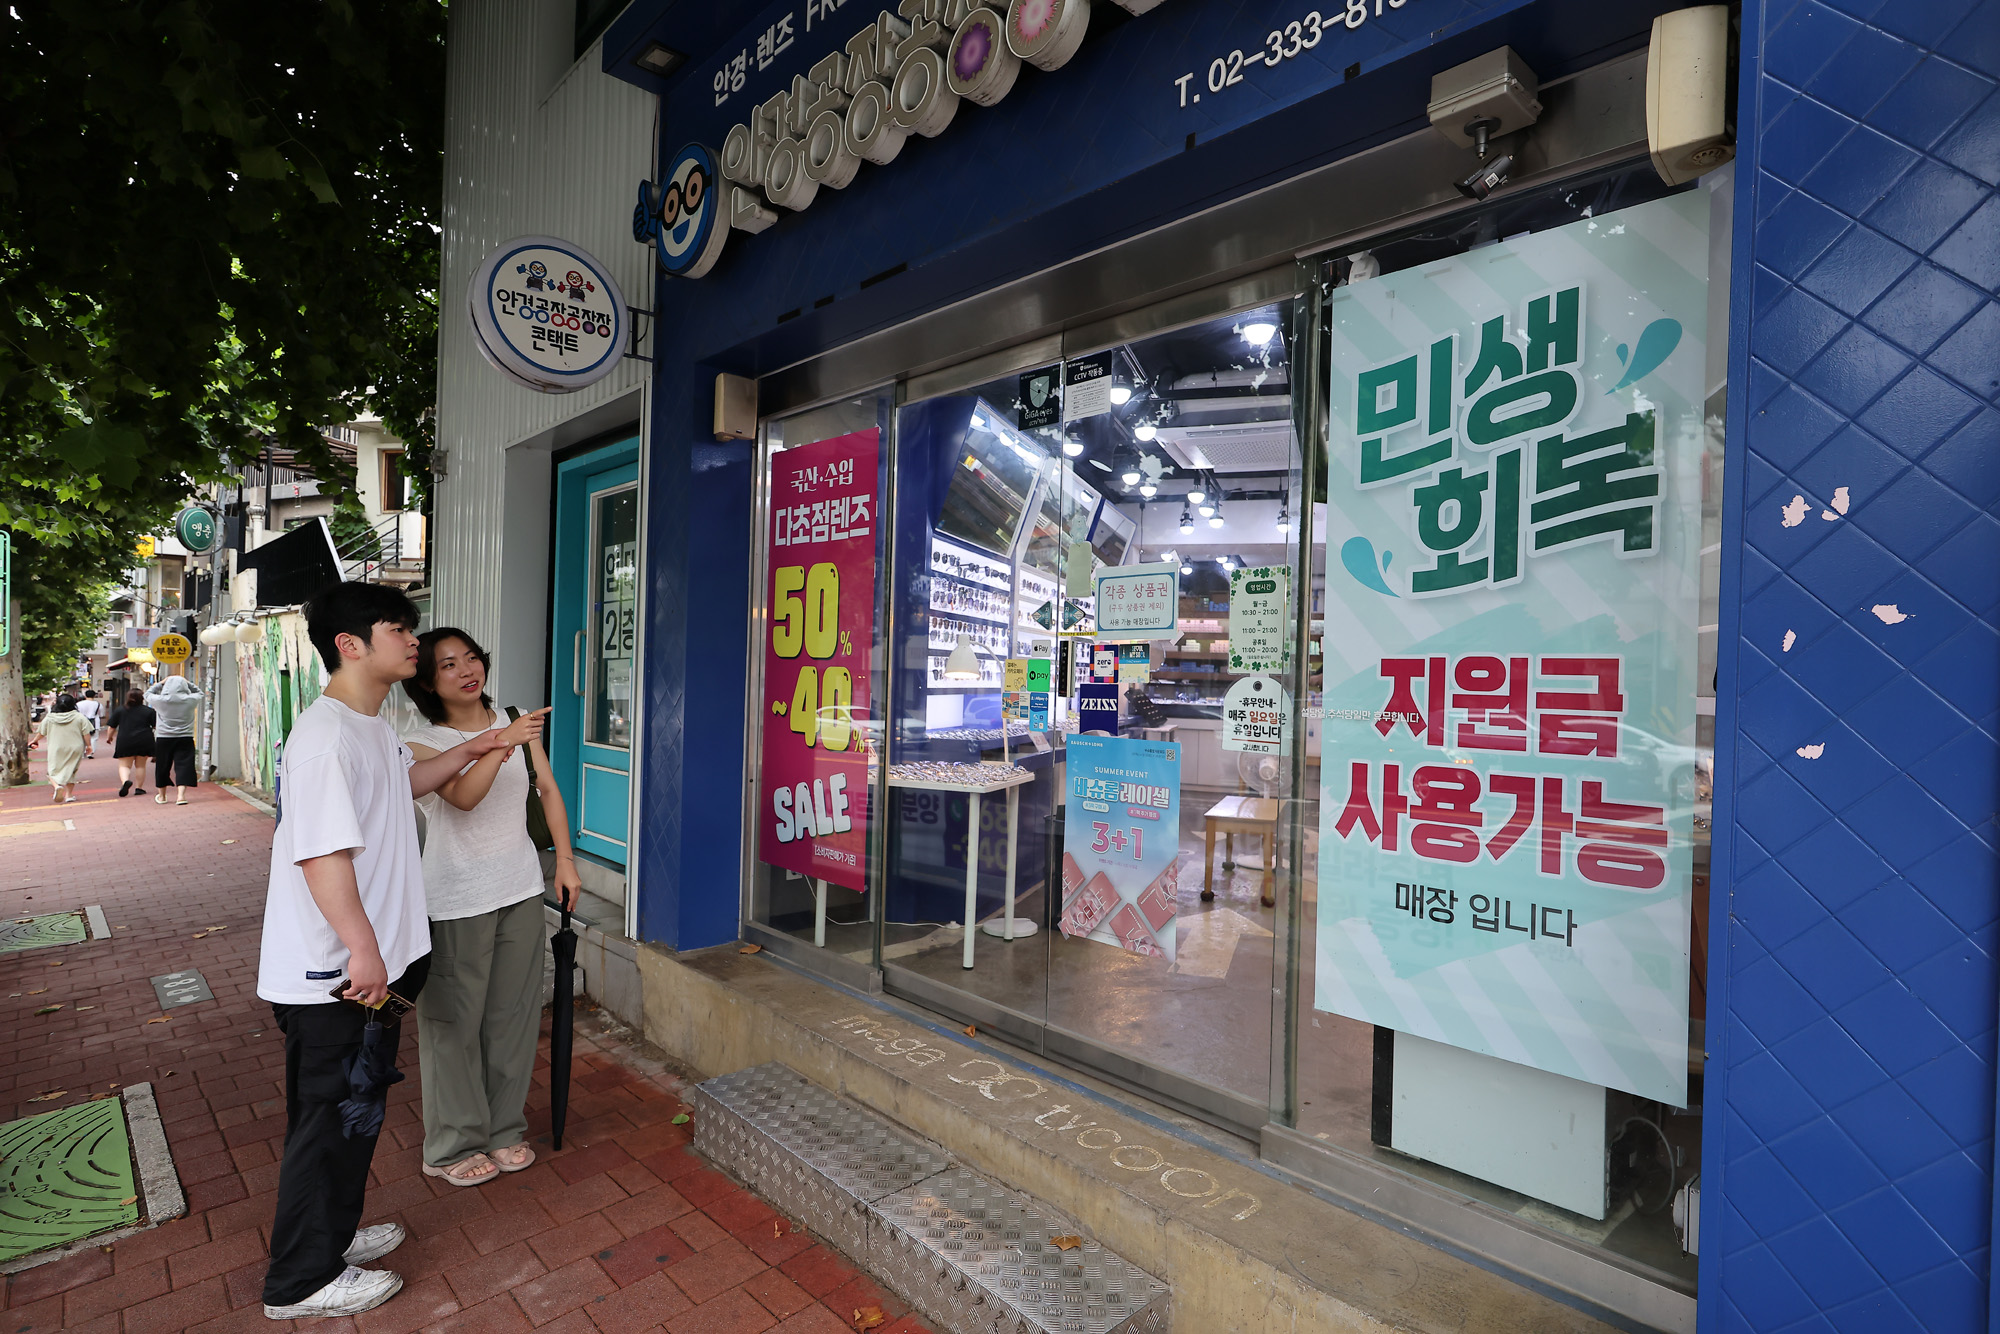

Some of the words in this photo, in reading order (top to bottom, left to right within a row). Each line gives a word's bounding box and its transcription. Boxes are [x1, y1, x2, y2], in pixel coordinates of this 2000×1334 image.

[1174, 72, 1200, 108] T.
[496, 289, 612, 338] 안경공장공장장
[531, 325, 579, 356] 콘택트
[1074, 372, 1087, 381] CCTV
[1357, 286, 1580, 485] 민생
[1412, 408, 1659, 593] 회복
[774, 494, 870, 546] 다초점렌즈
[1105, 585, 1126, 600] 각종
[1132, 582, 1168, 599] 상품권
[1250, 583, 1271, 591] 영업시간
[772, 562, 852, 659] 50%
[1121, 618, 1131, 626] 가능
[1126, 603, 1145, 612] 상품권
[156, 647, 187, 655] 부동산
[161, 637, 181, 646] 대운
[1037, 672, 1048, 680] pay
[1081, 698, 1117, 711] ZEISS
[1228, 709, 1247, 722] 매주
[1249, 710, 1287, 725] 일요일은
[1374, 656, 1624, 758] 지원금
[1374, 710, 1420, 723] 휴무합니다
[1233, 723, 1281, 739] 휴일입니다
[1094, 766, 1124, 776] SUMMER
[1126, 769, 1148, 779] EVENT
[773, 772, 852, 843] SALE
[1073, 776, 1119, 802] 바슈롬
[1120, 782, 1170, 809] 레이셀
[1090, 820, 1144, 861] 3+1
[1334, 762, 1669, 889] 사용가능
[1395, 883, 1458, 925] 매장
[1469, 893, 1578, 947] 입니다
[1033, 1103, 1262, 1222] tycoon
